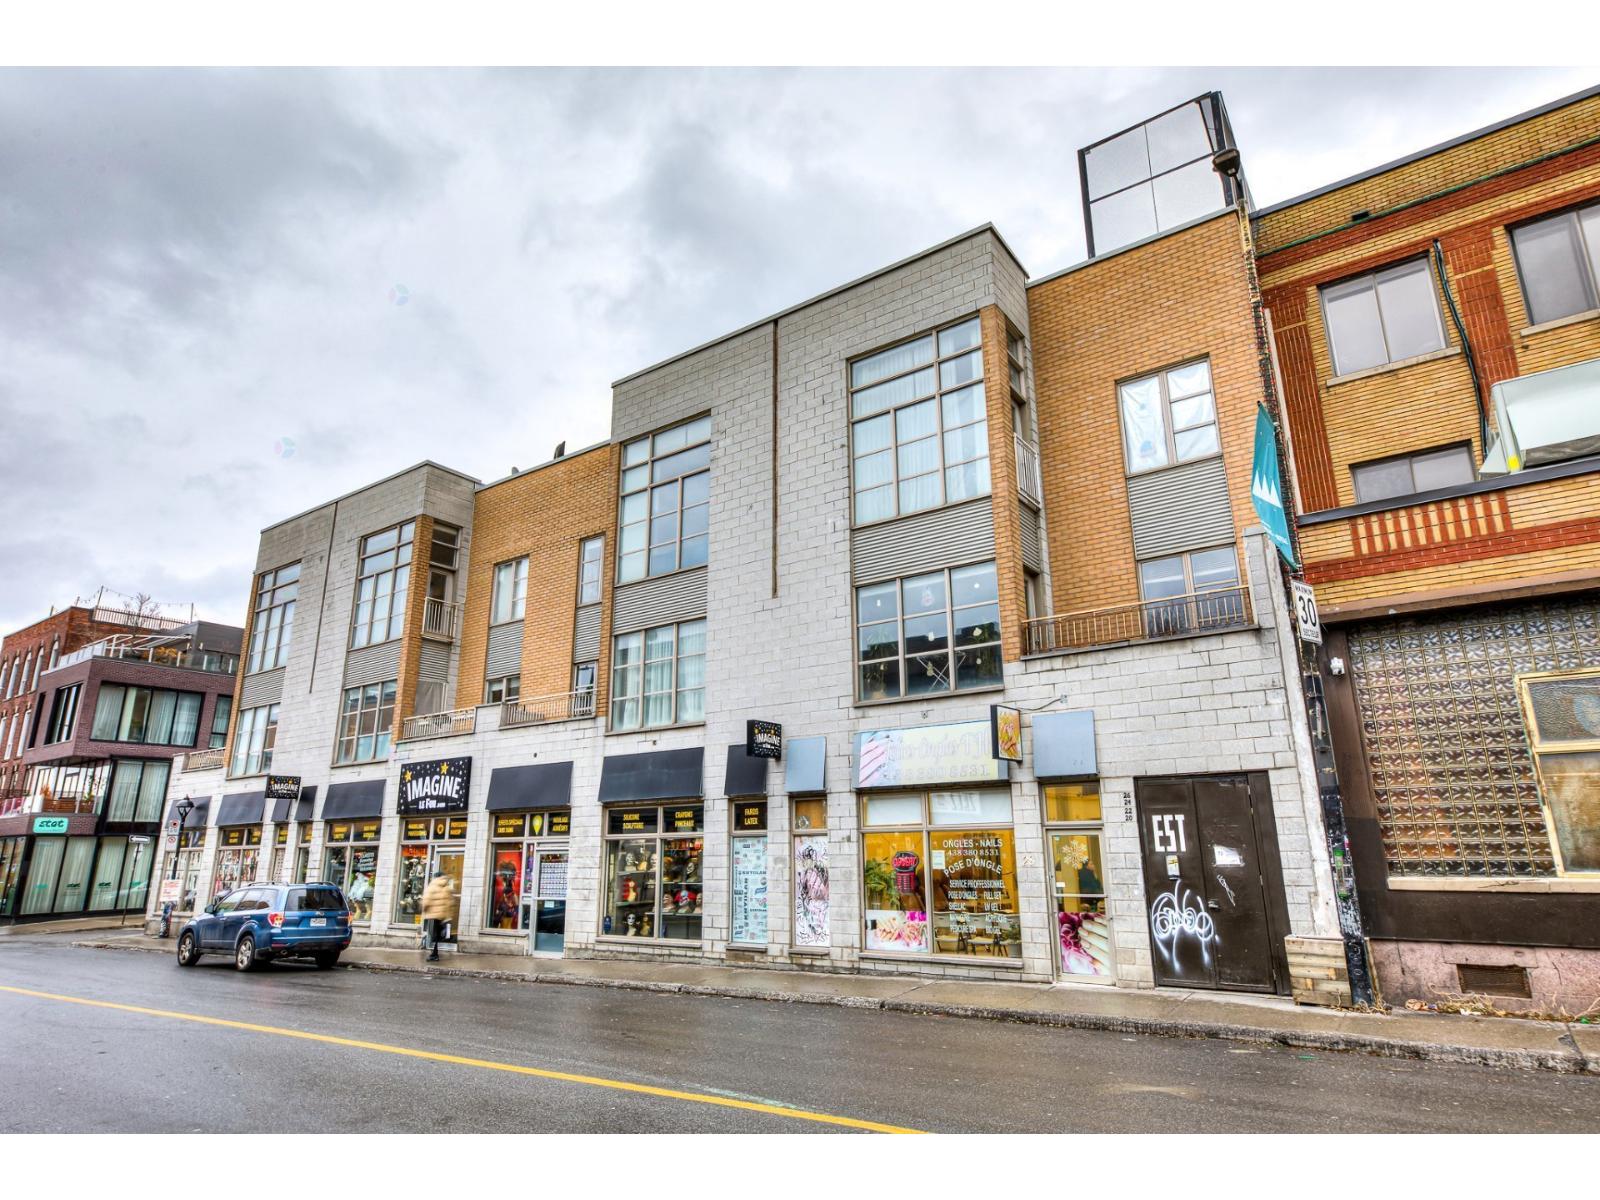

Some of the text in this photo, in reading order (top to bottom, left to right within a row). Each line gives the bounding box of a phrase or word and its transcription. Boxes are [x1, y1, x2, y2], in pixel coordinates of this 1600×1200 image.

[1298, 595, 1317, 627] 30
[756, 733, 781, 746] IMAGINE
[272, 783, 299, 792] IMAGINE
[406, 775, 462, 801] IMAGINE
[675, 811, 694, 819] CRAYONS
[1151, 814, 1187, 852] EST
[943, 839, 974, 848] ONGLES
[980, 838, 1003, 848] NAILS
[943, 859, 965, 878] POSE
[966, 857, 1003, 875] D'ONGLE
[950, 880, 967, 889] SERVICE
